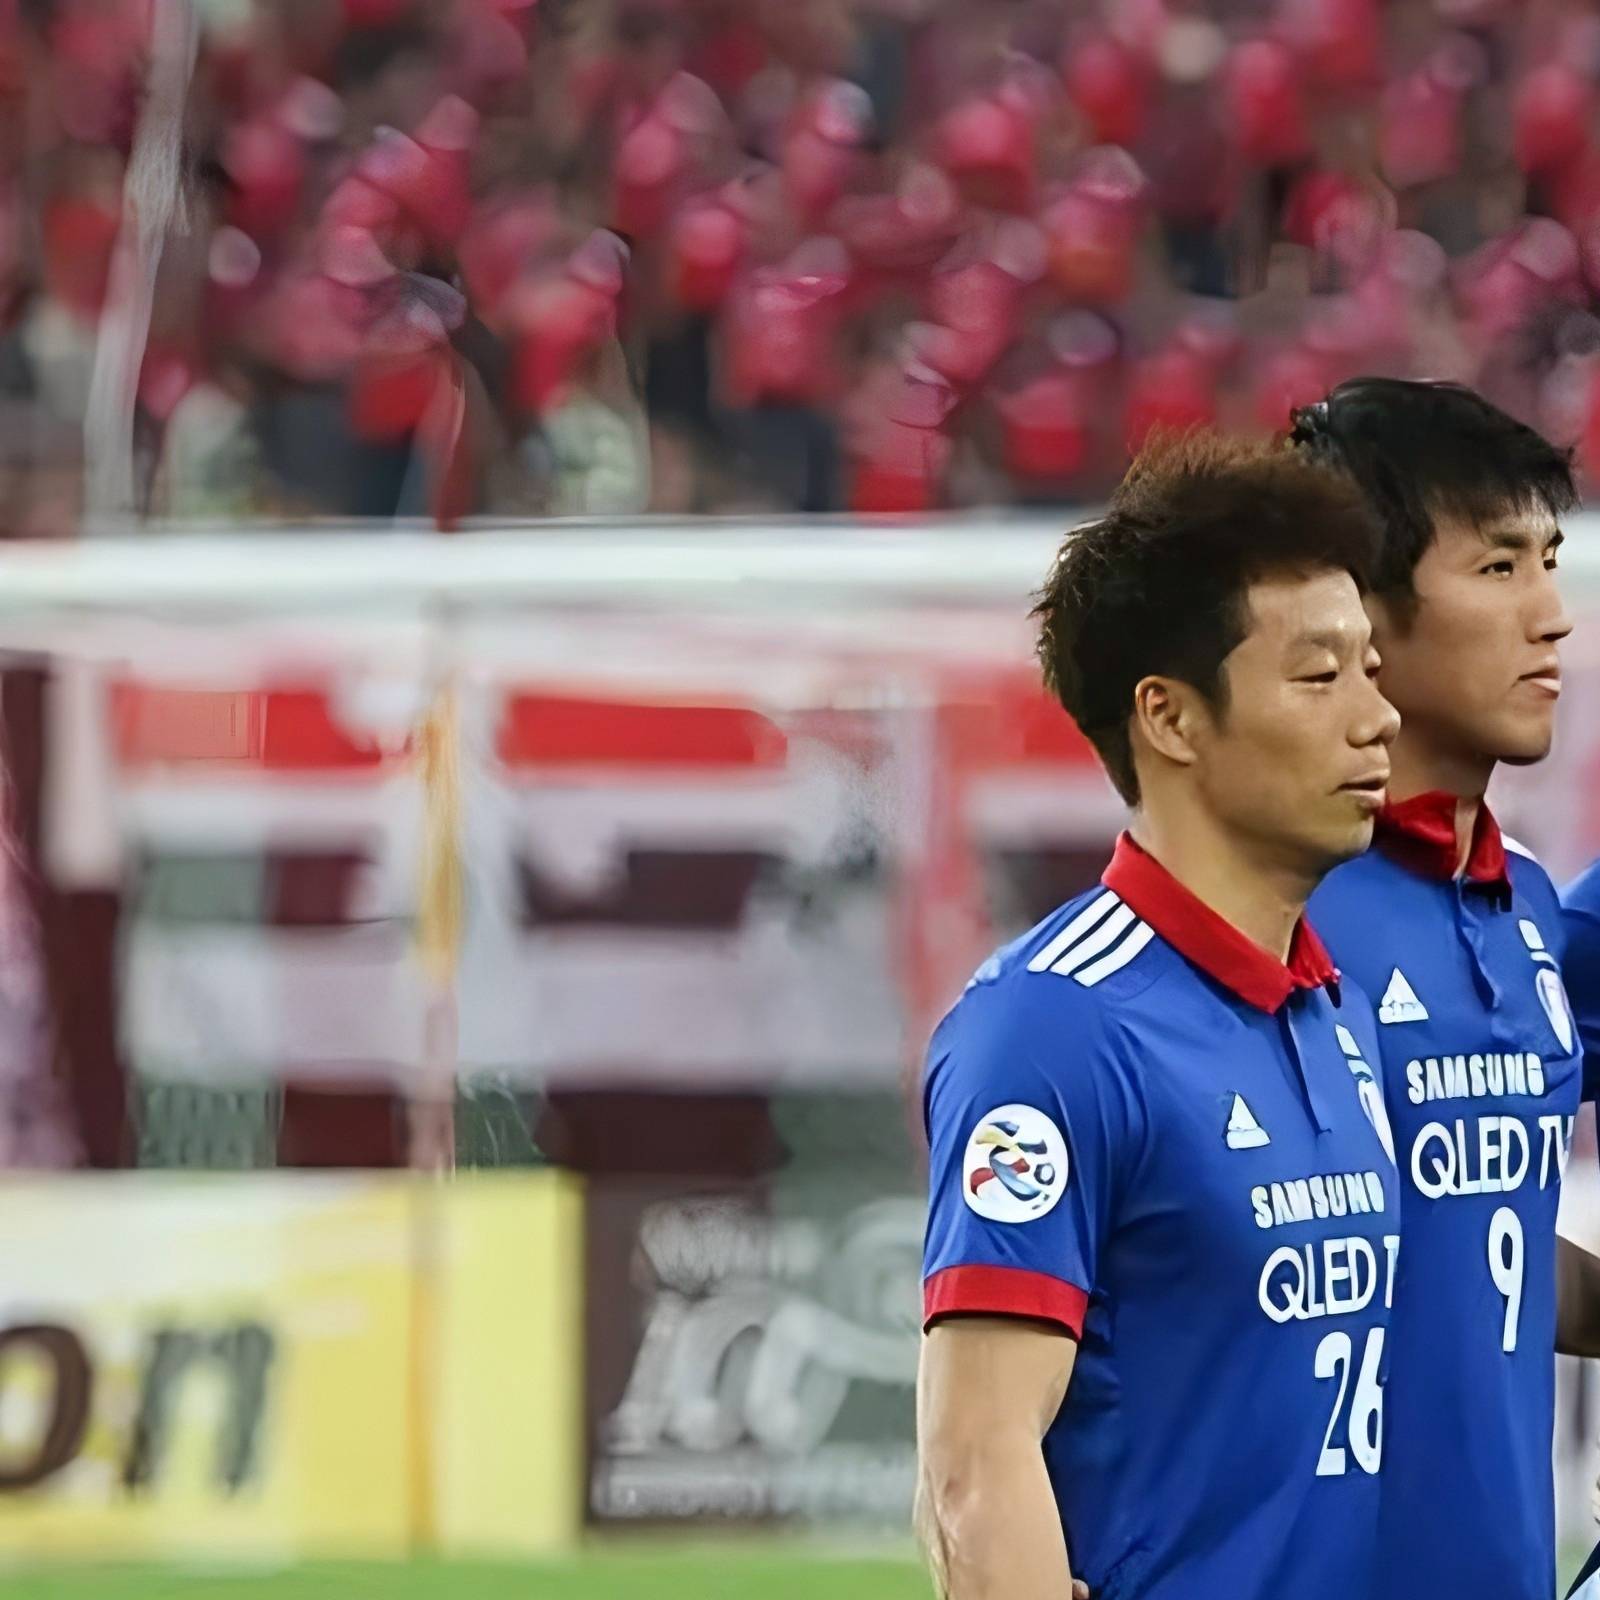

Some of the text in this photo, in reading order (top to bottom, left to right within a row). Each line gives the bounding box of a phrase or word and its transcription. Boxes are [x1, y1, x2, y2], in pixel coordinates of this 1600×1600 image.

[1406, 1053, 1545, 1104] SAMSUNG
[1411, 1115, 1530, 1199] QLED
[1258, 1236, 1378, 1323] QLED
[1488, 1207, 1525, 1352] 9
[1314, 1327, 1385, 1476] 26
